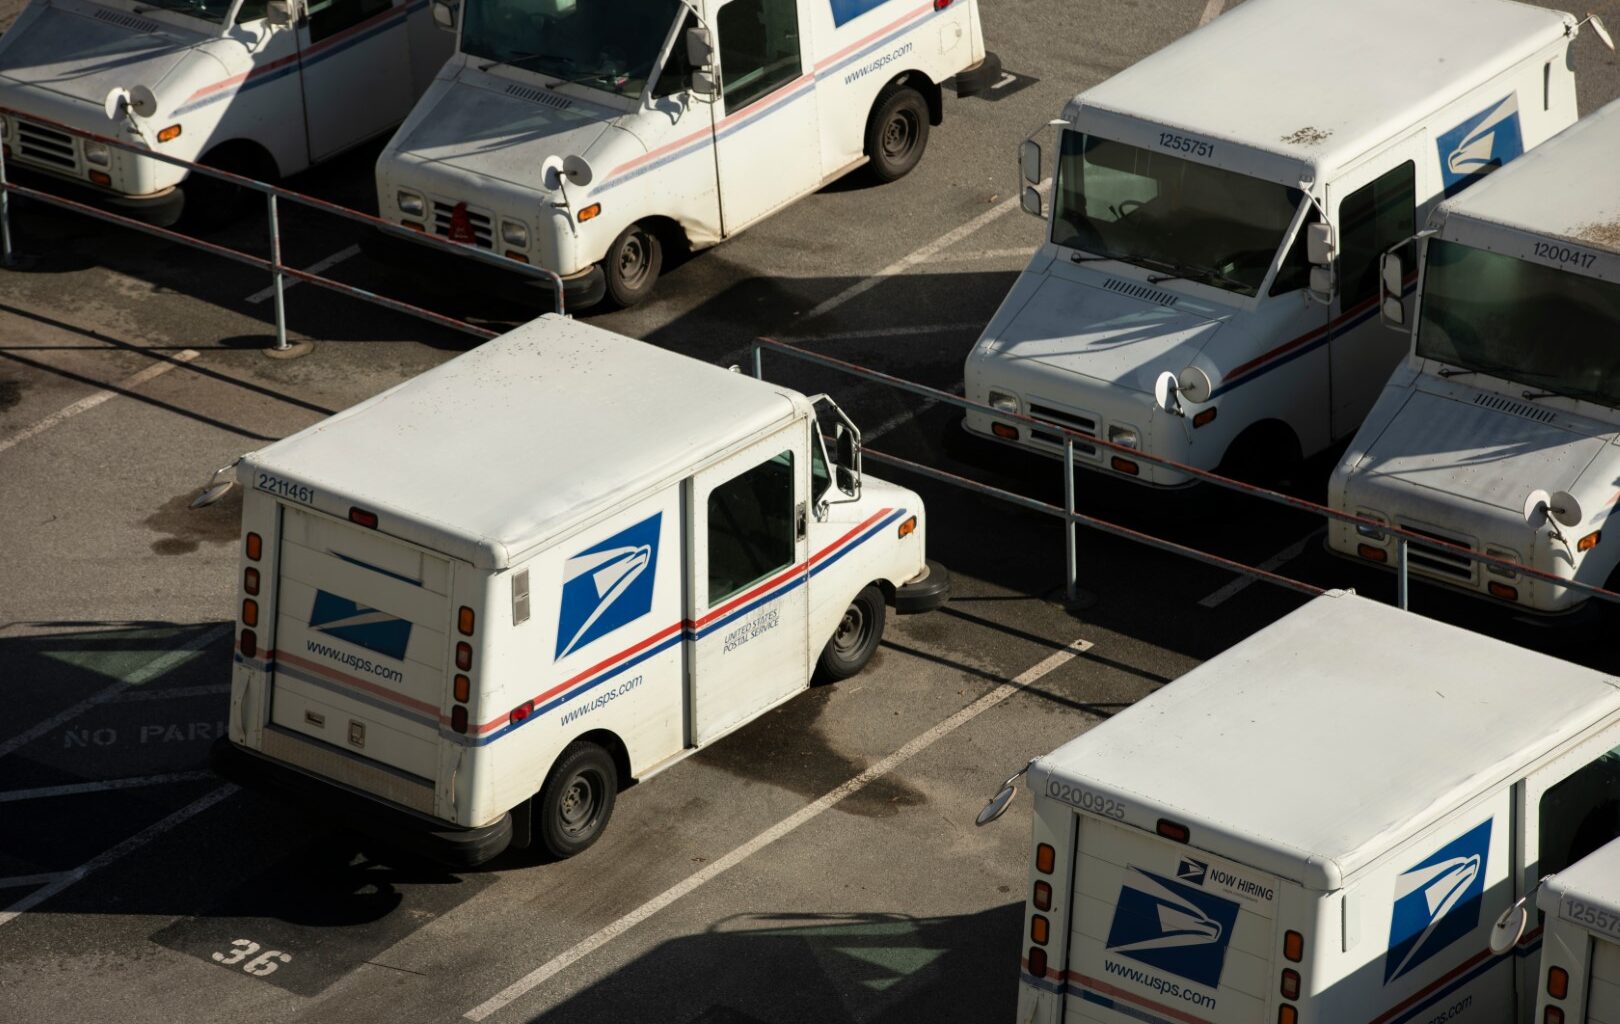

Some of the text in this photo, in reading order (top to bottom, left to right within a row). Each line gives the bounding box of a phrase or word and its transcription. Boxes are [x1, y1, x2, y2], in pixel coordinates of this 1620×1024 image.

[844, 42, 912, 85] www.usps.com
[1160, 132, 1214, 158] 1255751
[1533, 241, 1597, 269] 1200417
[259, 473, 314, 504] 2211461
[723, 617, 779, 654] POSTAL SERVICE
[724, 608, 778, 644] UNITED STATES
[306, 639, 403, 684] www.usps.com
[560, 675, 643, 727] www.usps.com
[64, 727, 117, 748] NO
[1050, 780, 1126, 819] 0200925
[1210, 868, 1237, 888] NOW
[1237, 877, 1274, 901] HIRING
[1567, 900, 1620, 933] 12557
[212, 938, 292, 976] 36
[1104, 959, 1216, 1010] www.usps.com
